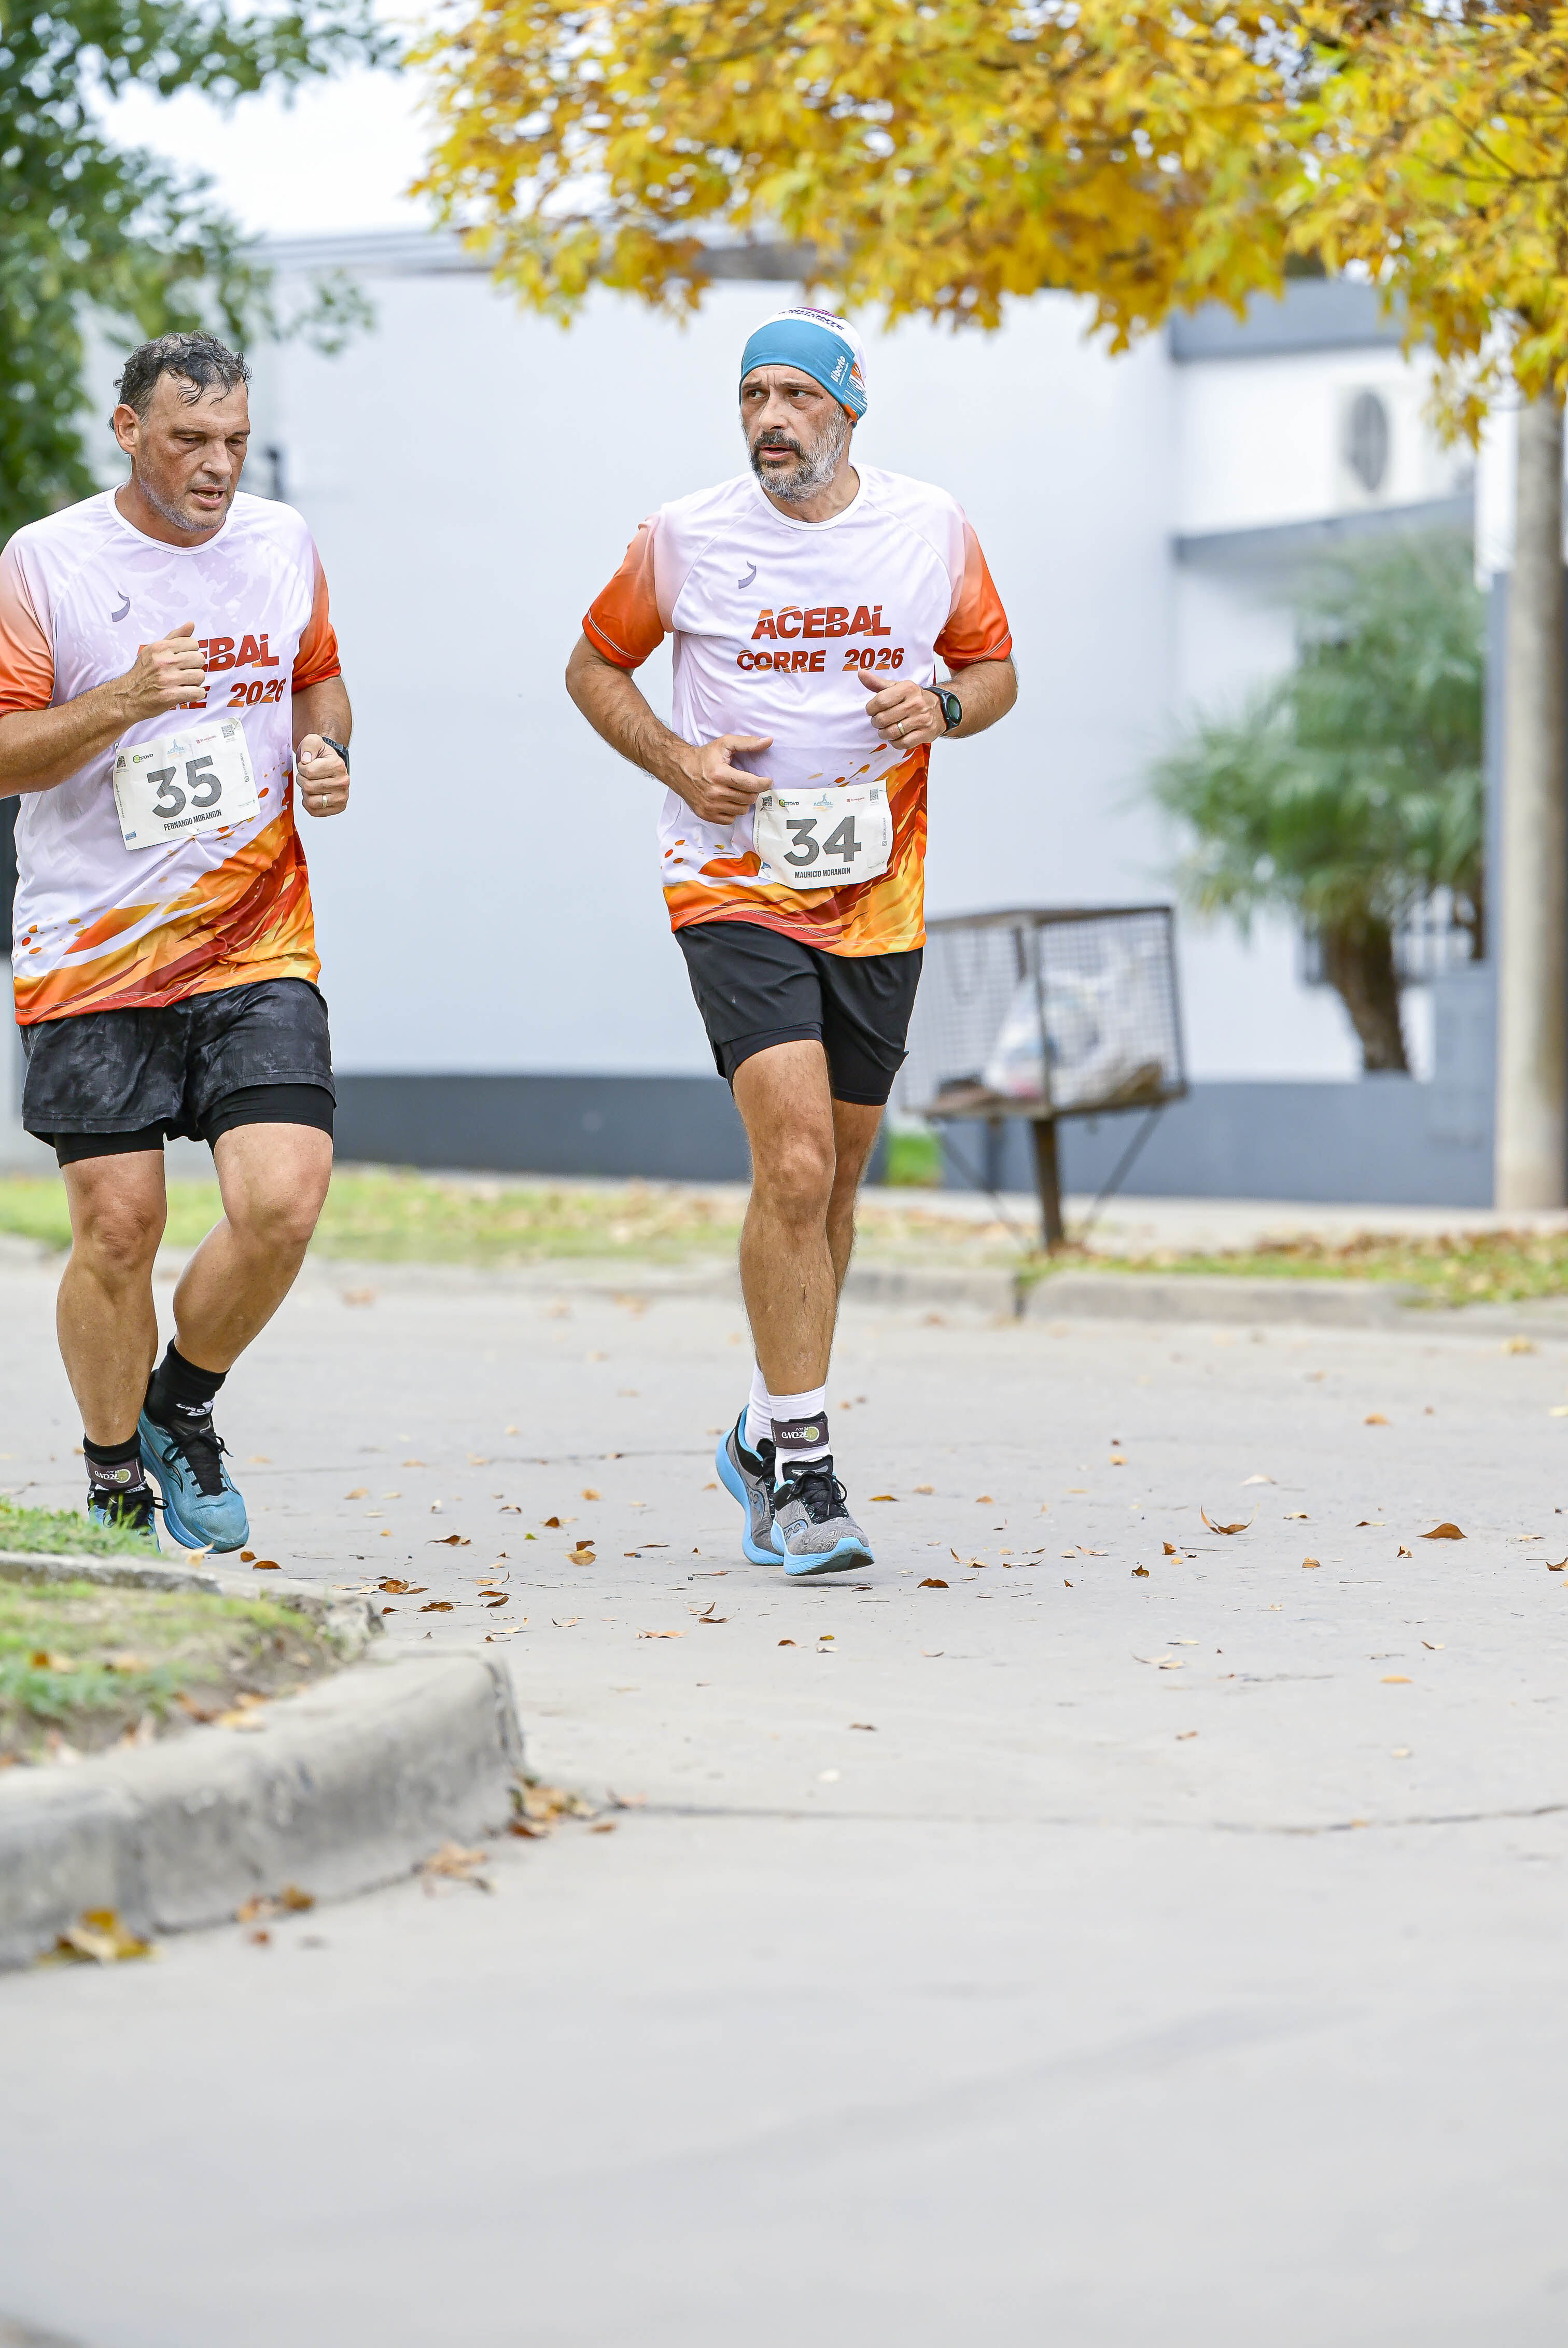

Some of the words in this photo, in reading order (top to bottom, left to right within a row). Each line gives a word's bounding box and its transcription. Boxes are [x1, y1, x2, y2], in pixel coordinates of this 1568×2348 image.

[778, 309, 845, 331] ORIZONTE
[830, 356, 846, 382] liberto
[751, 605, 891, 639] ACEBAL
[198, 634, 279, 673] BAL
[736, 649, 827, 673] CORRE
[842, 647, 905, 672] 2026
[227, 678, 287, 708] 2026
[147, 755, 222, 818] 35
[164, 818, 193, 831] FERNANDO
[193, 809, 222, 823] MORANDIN
[783, 816, 862, 866] 34
[794, 870, 821, 878] MAURICIO
[822, 867, 851, 876] MORANDIN
